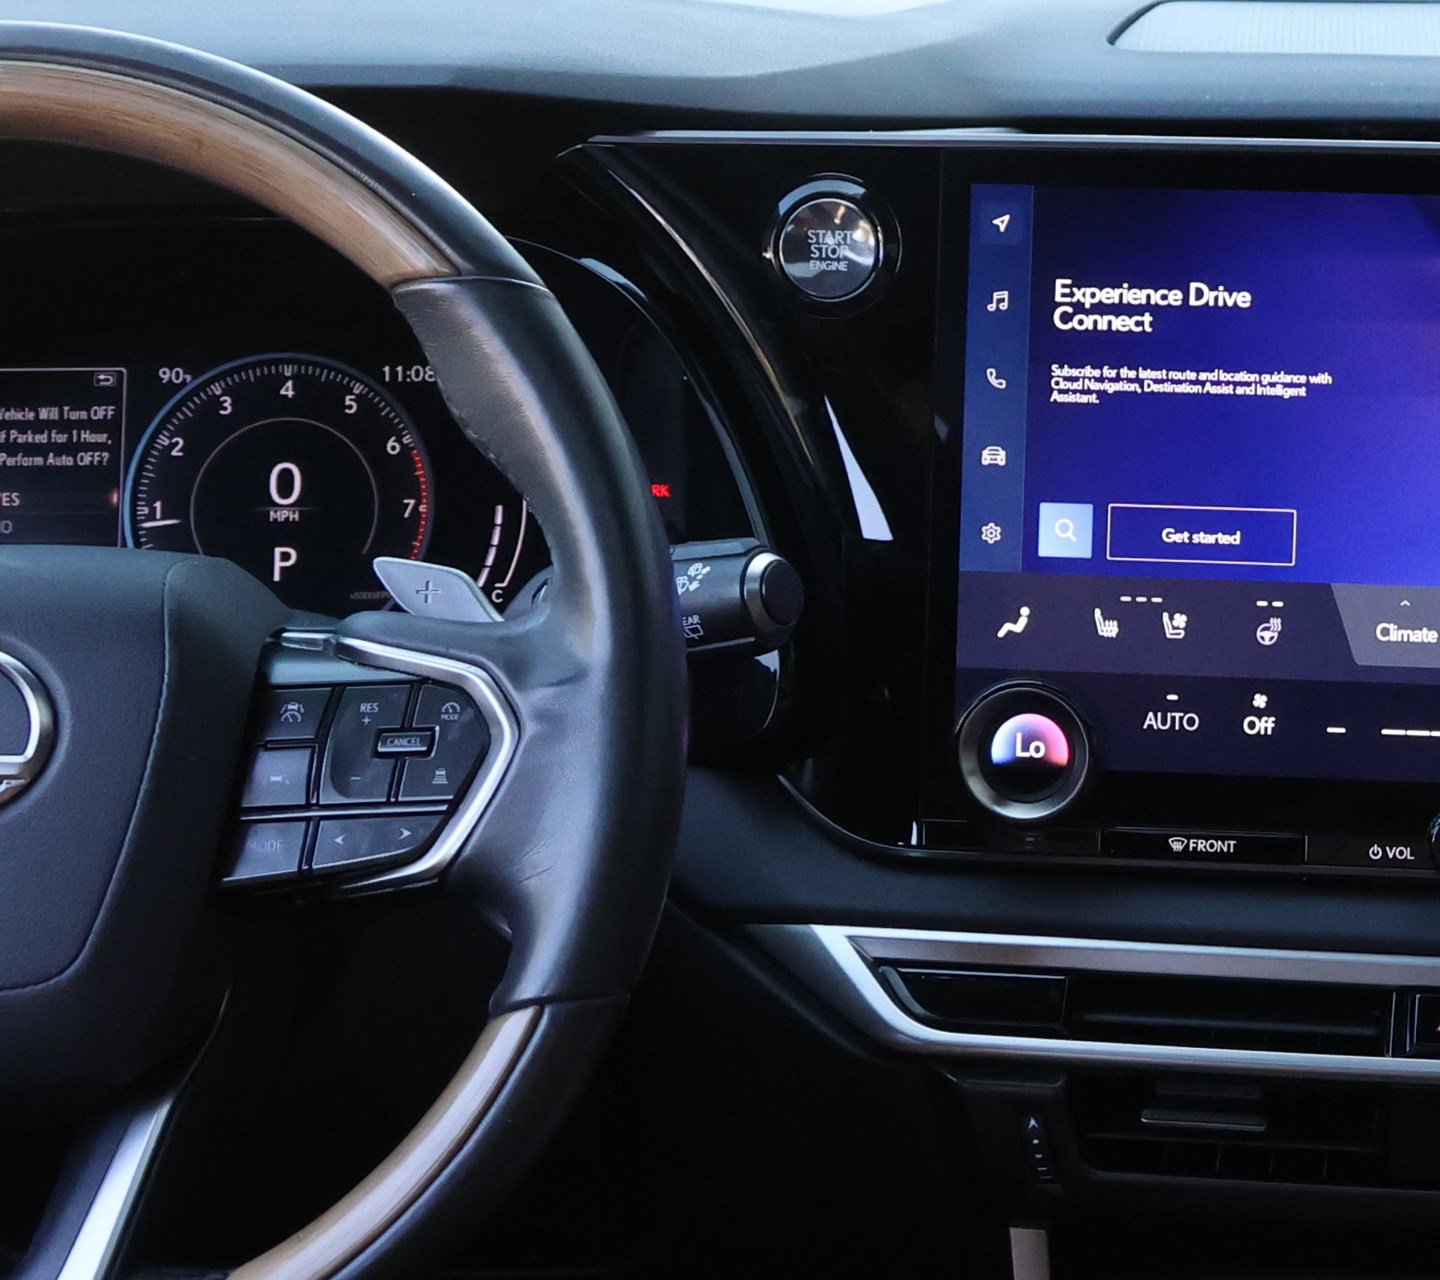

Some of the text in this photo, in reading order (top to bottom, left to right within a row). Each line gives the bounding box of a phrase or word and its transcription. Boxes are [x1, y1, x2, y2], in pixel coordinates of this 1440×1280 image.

[807, 229, 854, 245] START
[809, 245, 850, 259] STOP
[809, 260, 849, 272] ENGINE
[1054, 278, 1252, 308] Experience Drive
[1053, 306, 1153, 333] Connect
[382, 365, 437, 384] 11:08
[1050, 363, 1333, 385] Subscribe for the latest route and location guidance with
[279, 380, 295, 399] 4
[1050, 377, 1307, 399] Cloud Navigation, Destination Assist and Intelligent
[1050, 390, 1100, 404] Assistant.
[38, 406, 60, 421] Will
[63, 406, 88, 421] Turn
[90, 406, 116, 421] OFF
[218, 396, 233, 416] 3
[343, 395, 358, 414] 5
[9, 430, 48, 444] Parked
[50, 430, 70, 444] for
[80, 430, 113, 445] Hour,
[385, 436, 402, 455] 6
[170, 438, 185, 457] 2
[46, 452, 74, 467] Auto
[76, 451, 111, 467] OFF?
[268, 461, 303, 506] 0
[151, 501, 162, 519] 1
[269, 509, 300, 523] MPH
[402, 499, 416, 518] 7
[1161, 526, 1241, 547] Get started
[272, 546, 299, 582] P
[491, 589, 504, 604] C
[1375, 623, 1439, 645] Climate
[359, 702, 380, 714] RES
[1143, 711, 1200, 733] AUTO
[1242, 715, 1276, 737] Off
[386, 737, 422, 747] CANCEL
[1014, 732, 1047, 760] Lo
[1188, 837, 1238, 855] FRONT
[1385, 844, 1415, 861] VOL
